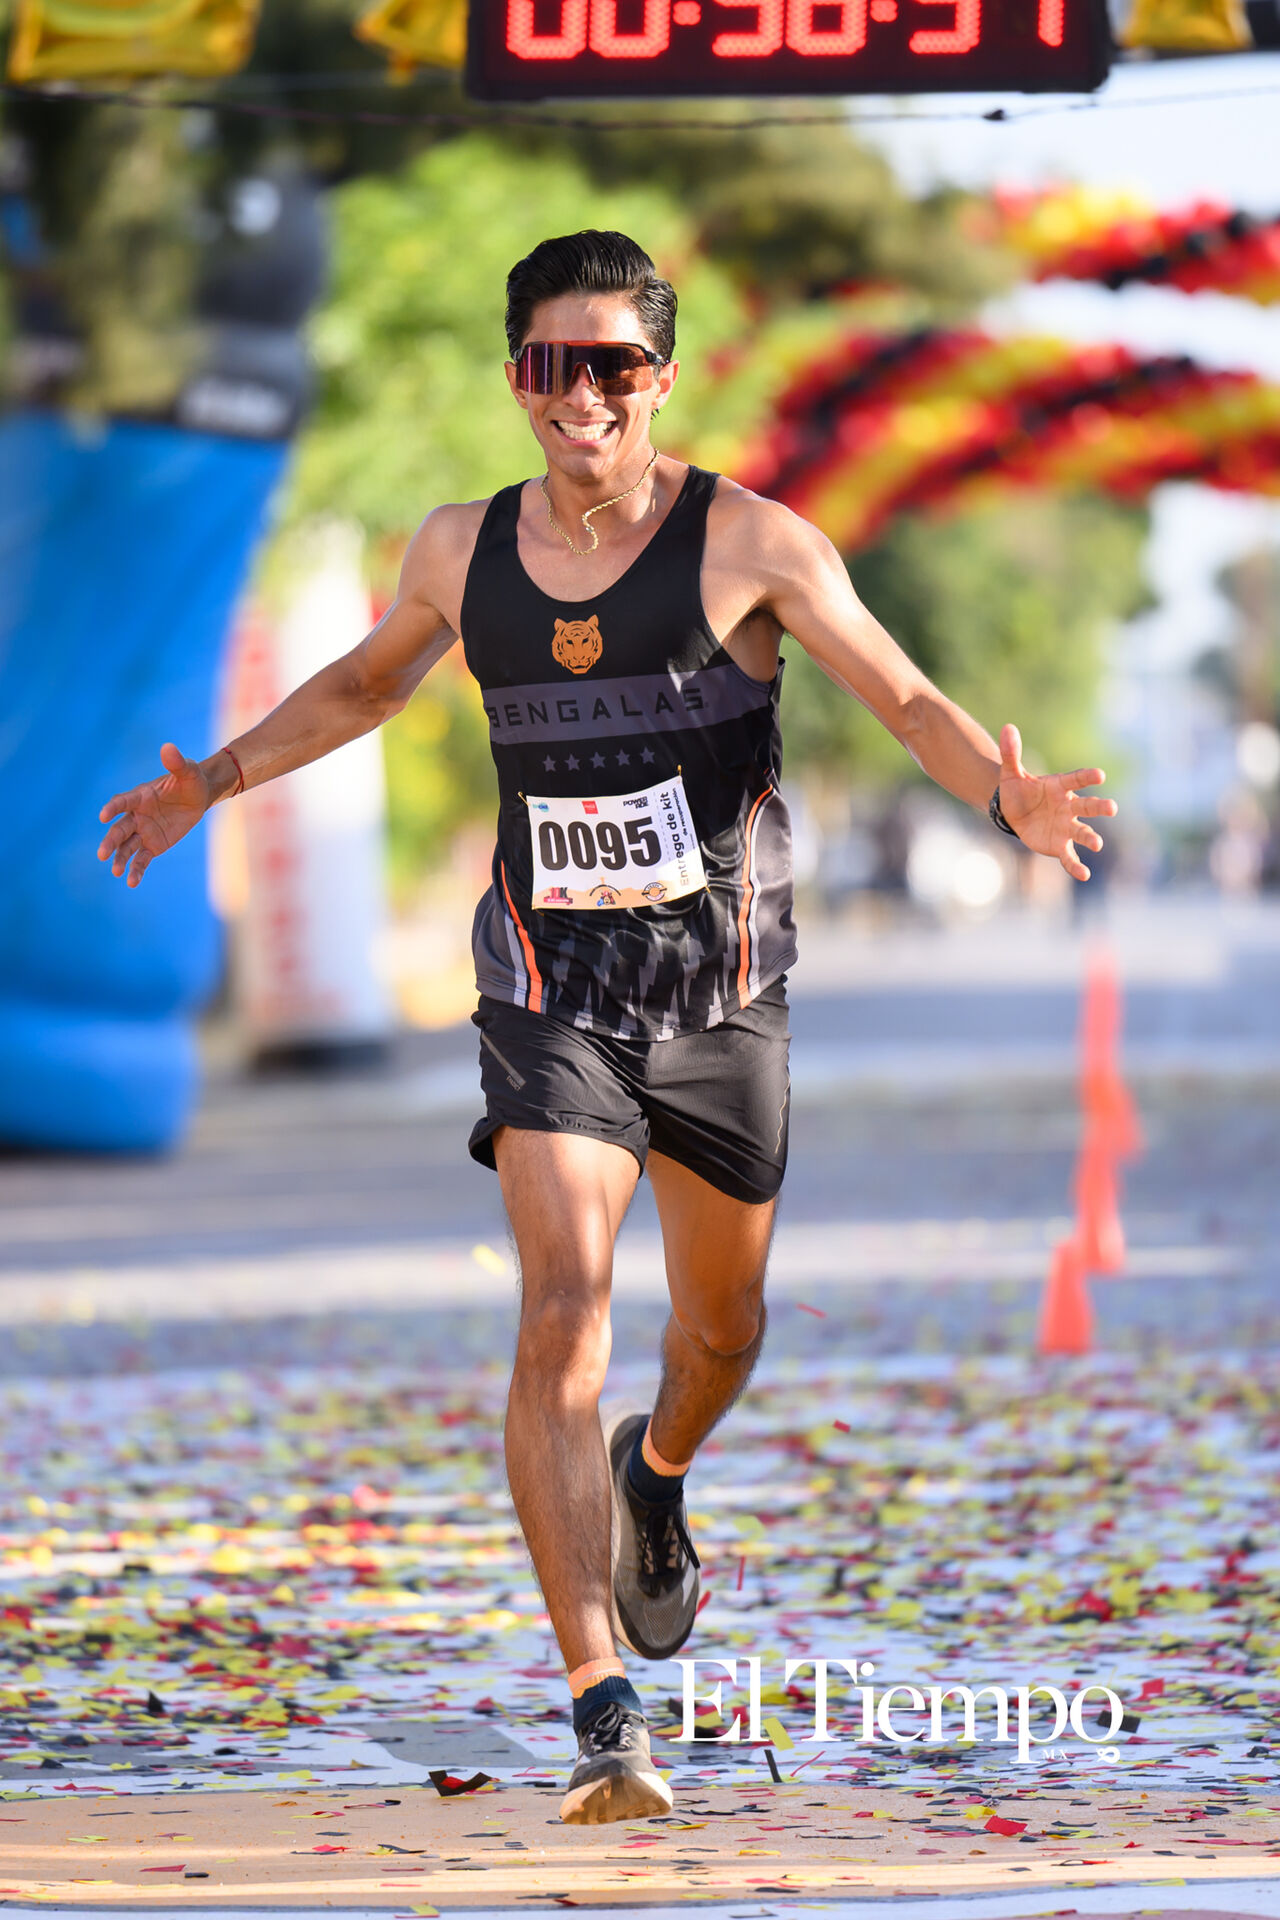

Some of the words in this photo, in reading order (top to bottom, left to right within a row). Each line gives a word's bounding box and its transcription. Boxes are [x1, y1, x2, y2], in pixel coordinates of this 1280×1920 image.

[486, 688, 704, 728] BENGALAS
[659, 791, 673, 810] kit
[667, 813, 677, 831] de
[538, 816, 662, 871] 0095
[671, 833, 690, 886] Entrega
